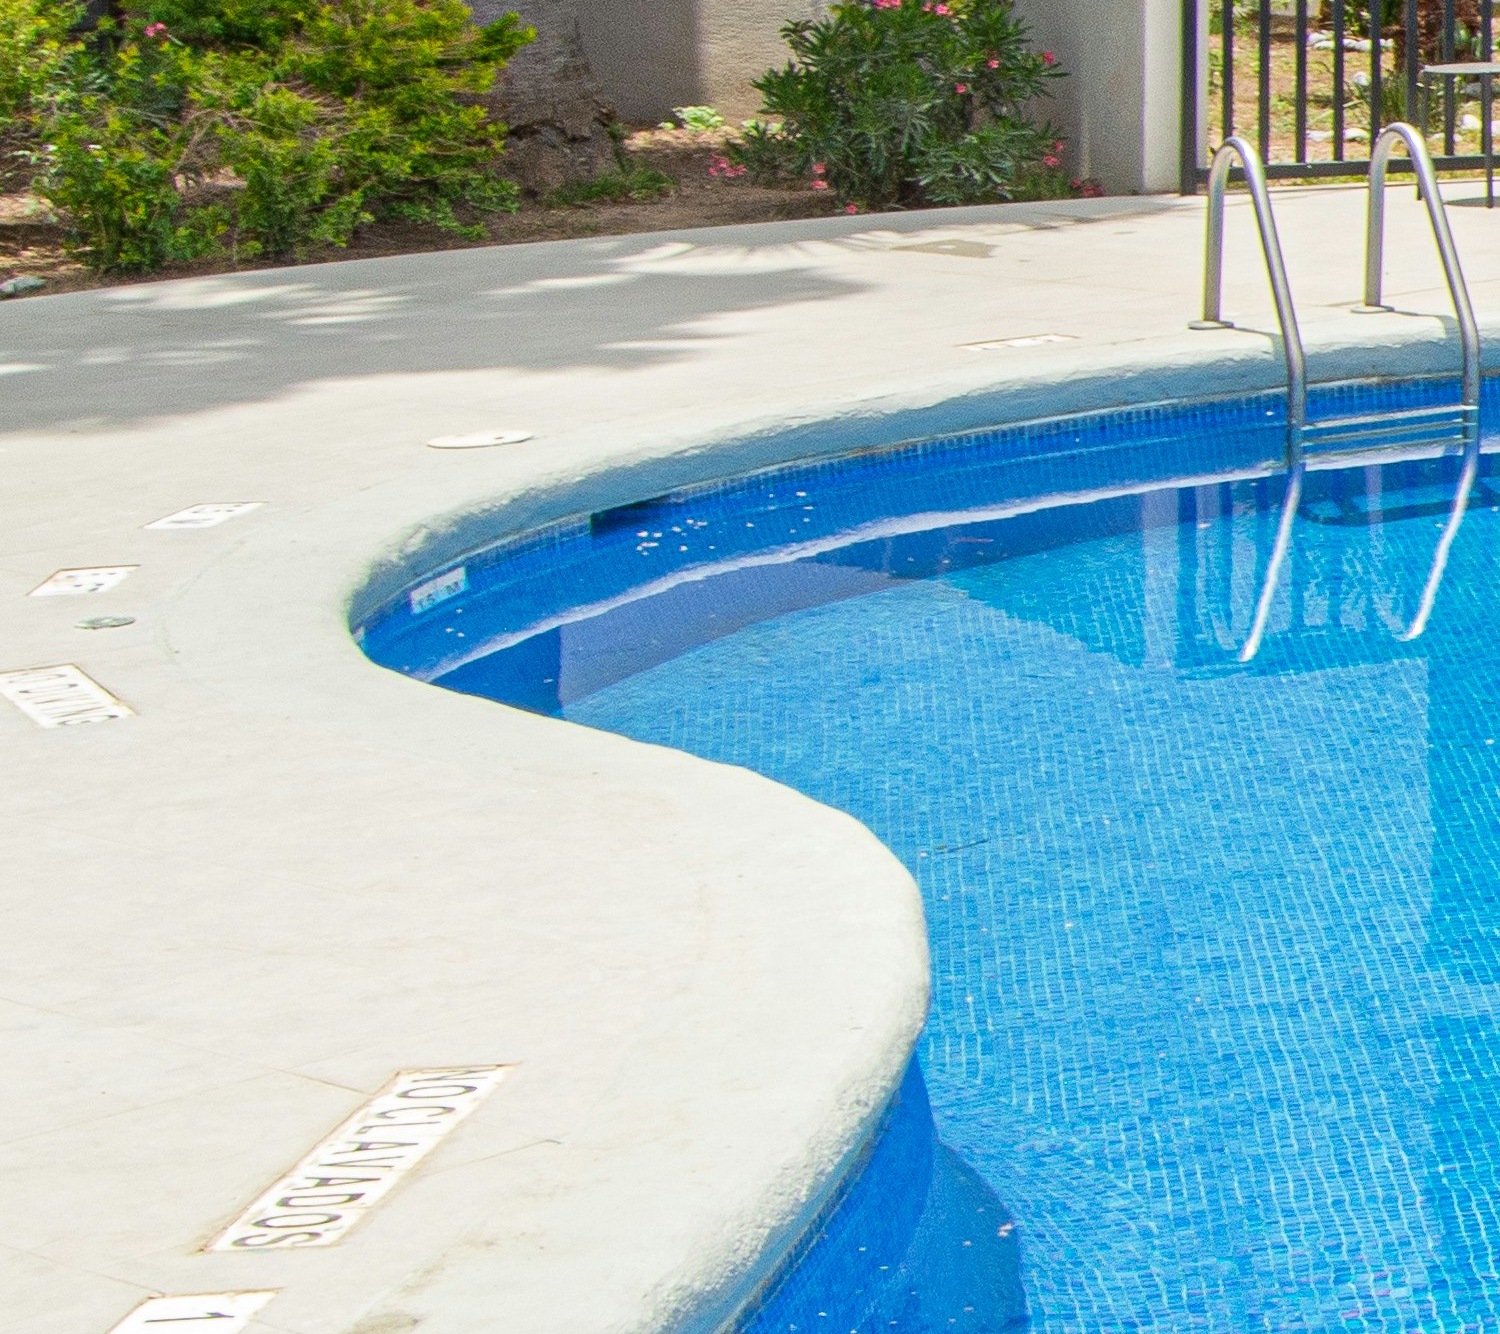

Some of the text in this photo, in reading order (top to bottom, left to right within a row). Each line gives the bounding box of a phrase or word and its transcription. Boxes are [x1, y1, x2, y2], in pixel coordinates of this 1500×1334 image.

[230, 1067, 497, 1248] NO CLAVADOS
[144, 1311, 235, 1324] 1
